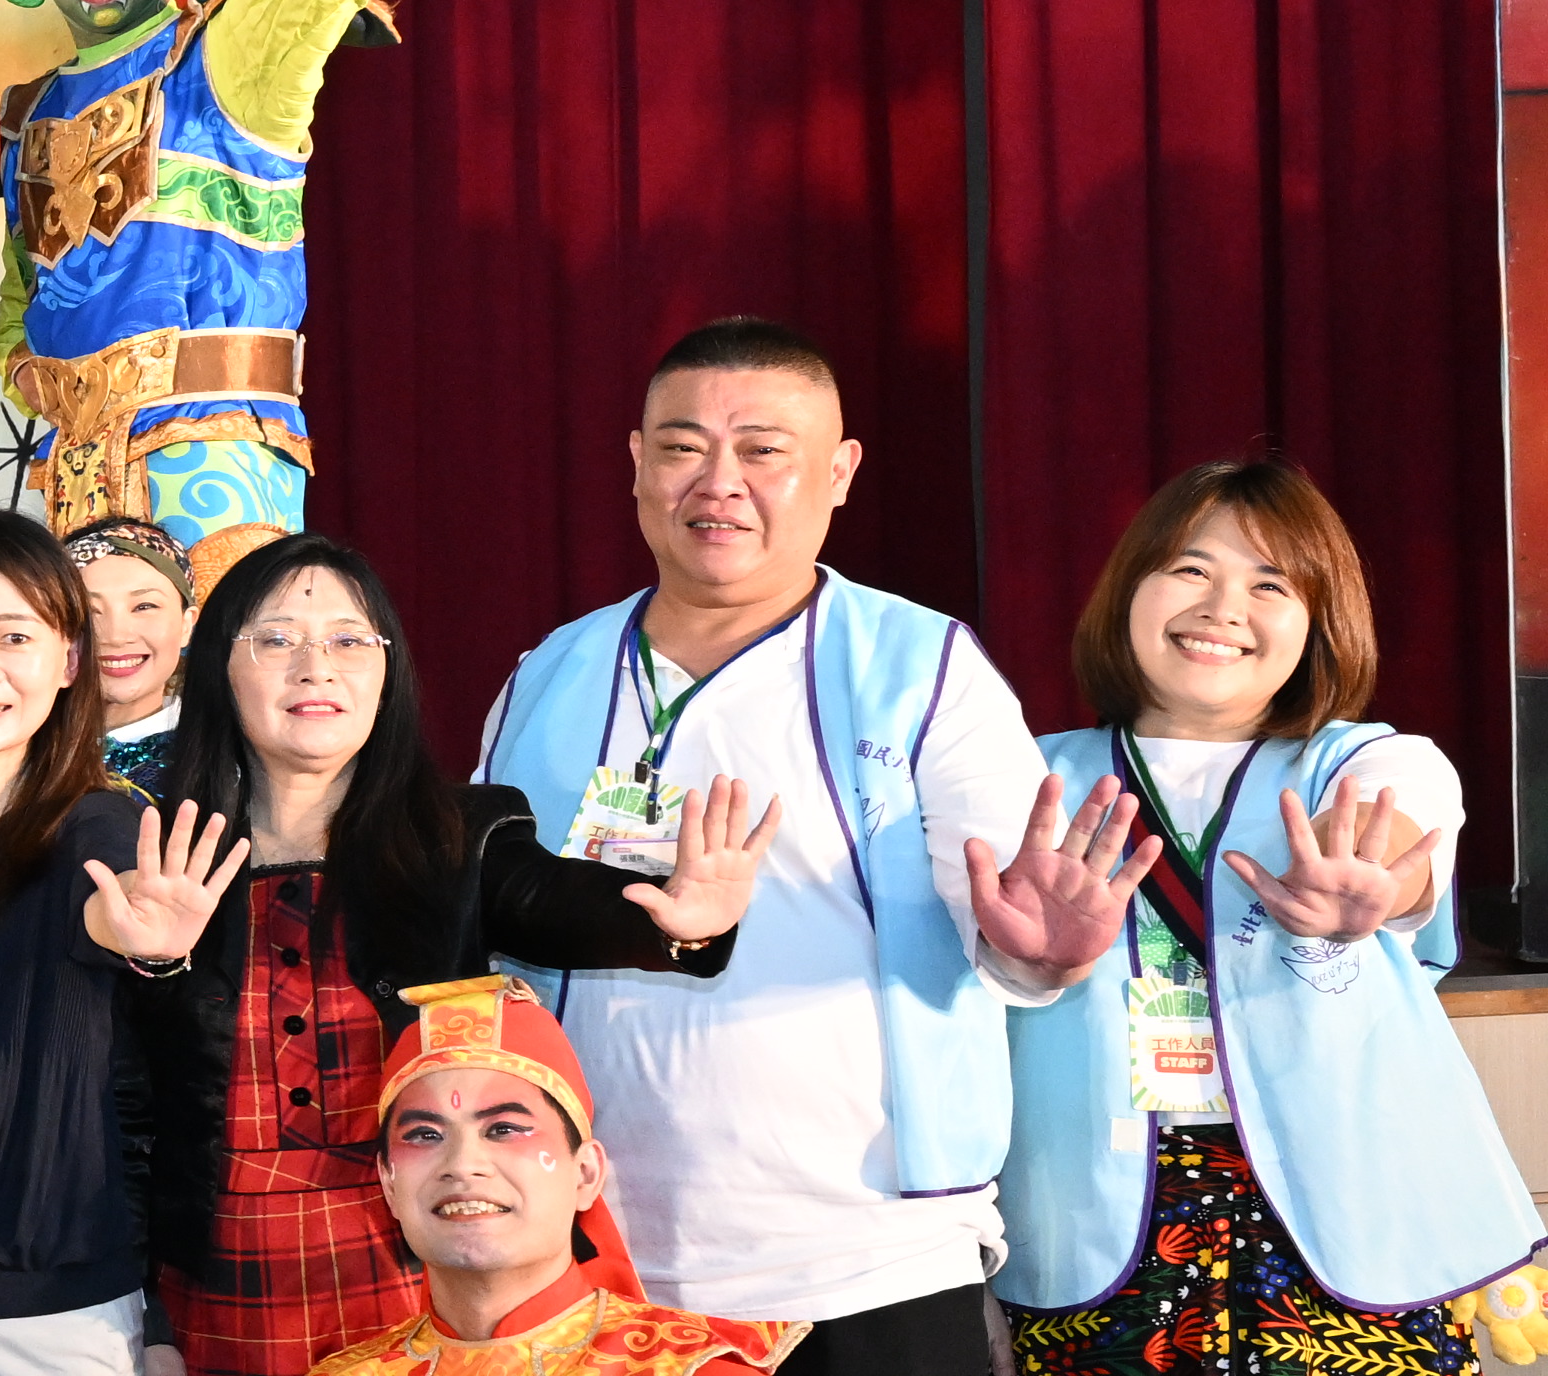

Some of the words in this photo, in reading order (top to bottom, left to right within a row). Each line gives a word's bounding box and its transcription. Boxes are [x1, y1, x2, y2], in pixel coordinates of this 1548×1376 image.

[1151, 1037, 1216, 1052] 工作人員
[1160, 1056, 1208, 1069] STAFF
